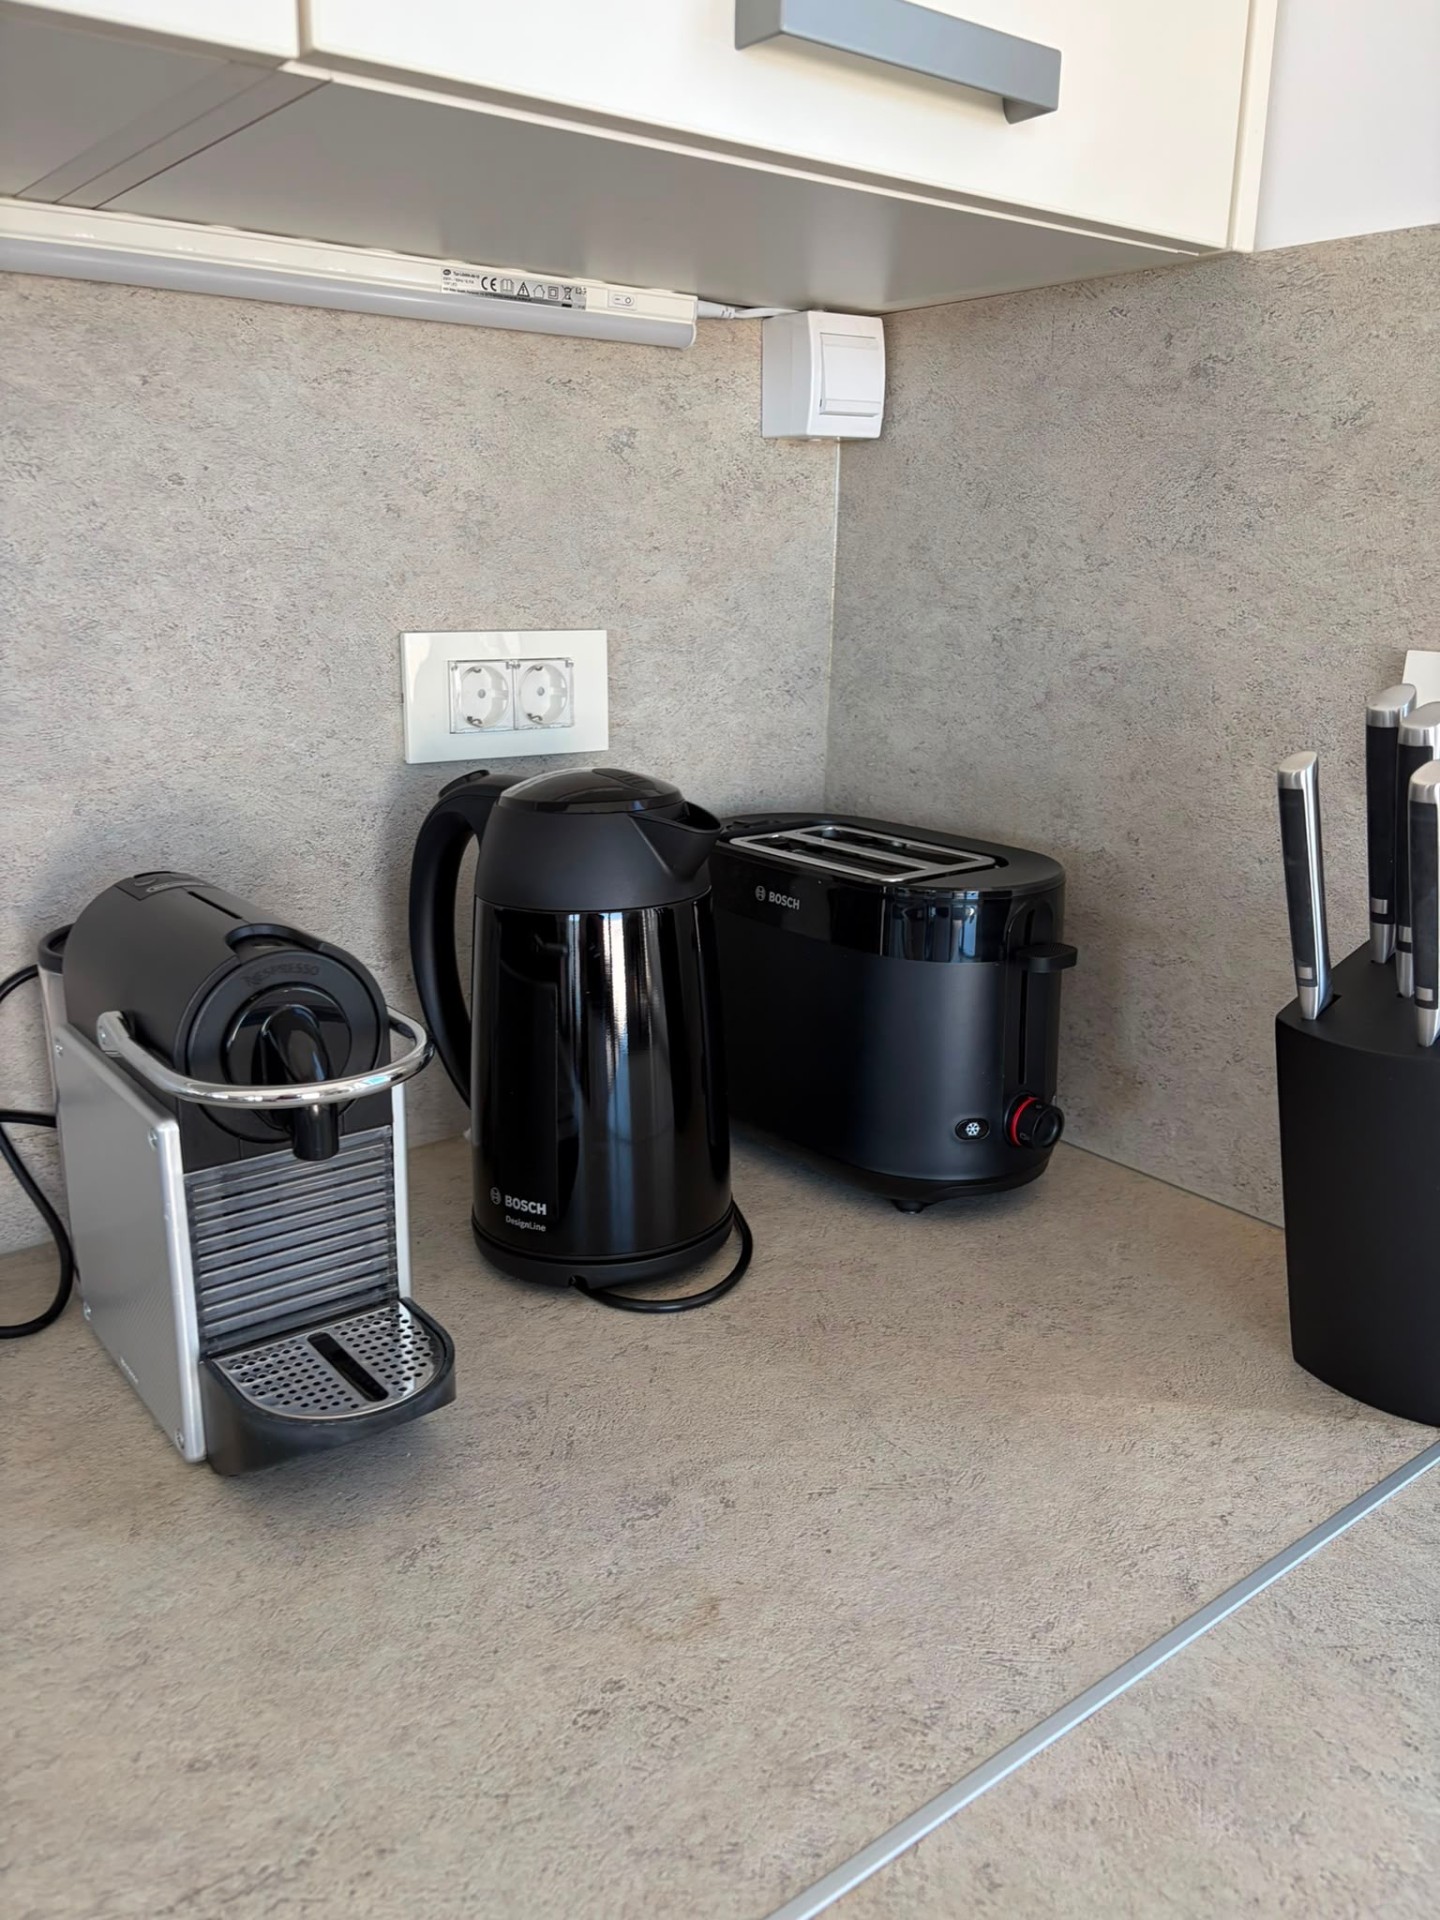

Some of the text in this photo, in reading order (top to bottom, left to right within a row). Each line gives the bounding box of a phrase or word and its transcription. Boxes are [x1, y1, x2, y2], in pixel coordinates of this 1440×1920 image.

[481, 276, 497, 292] CE
[768, 891, 800, 910] BOSCH
[505, 1194, 547, 1215] BOSCH
[505, 1215, 547, 1232] DesignLine
